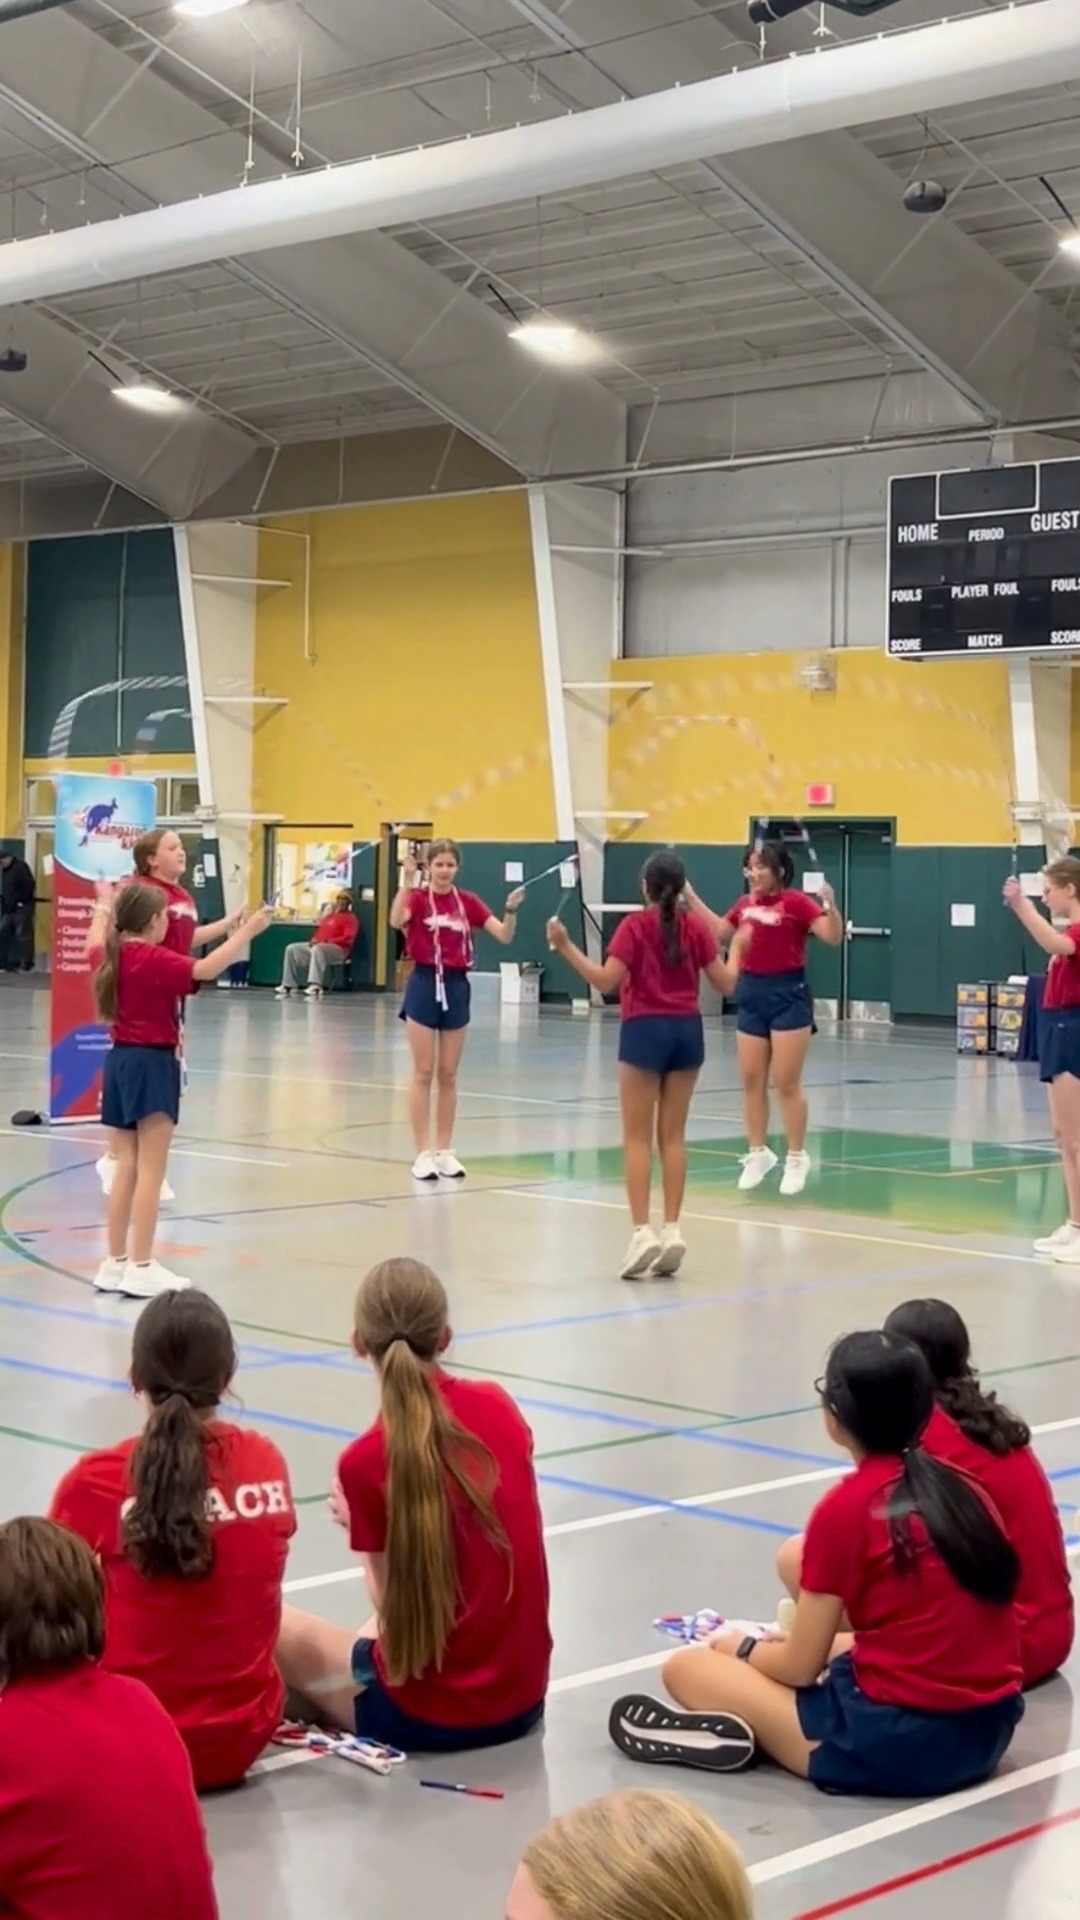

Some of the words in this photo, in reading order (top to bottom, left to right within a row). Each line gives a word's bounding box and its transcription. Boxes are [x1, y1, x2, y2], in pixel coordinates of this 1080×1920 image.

[1030, 511, 1080, 532] GUEST
[897, 523, 939, 543] HOME
[968, 527, 1004, 542] PERIOD
[891, 588, 922, 602] FOULS
[951, 583, 989, 599] PLAYER
[994, 582, 1019, 596] FOUL
[967, 634, 1003, 648] MATCH
[1050, 630, 1080, 644] SCOR
[890, 638, 922, 652] SCORE
[120, 1480, 290, 1522] ACH
